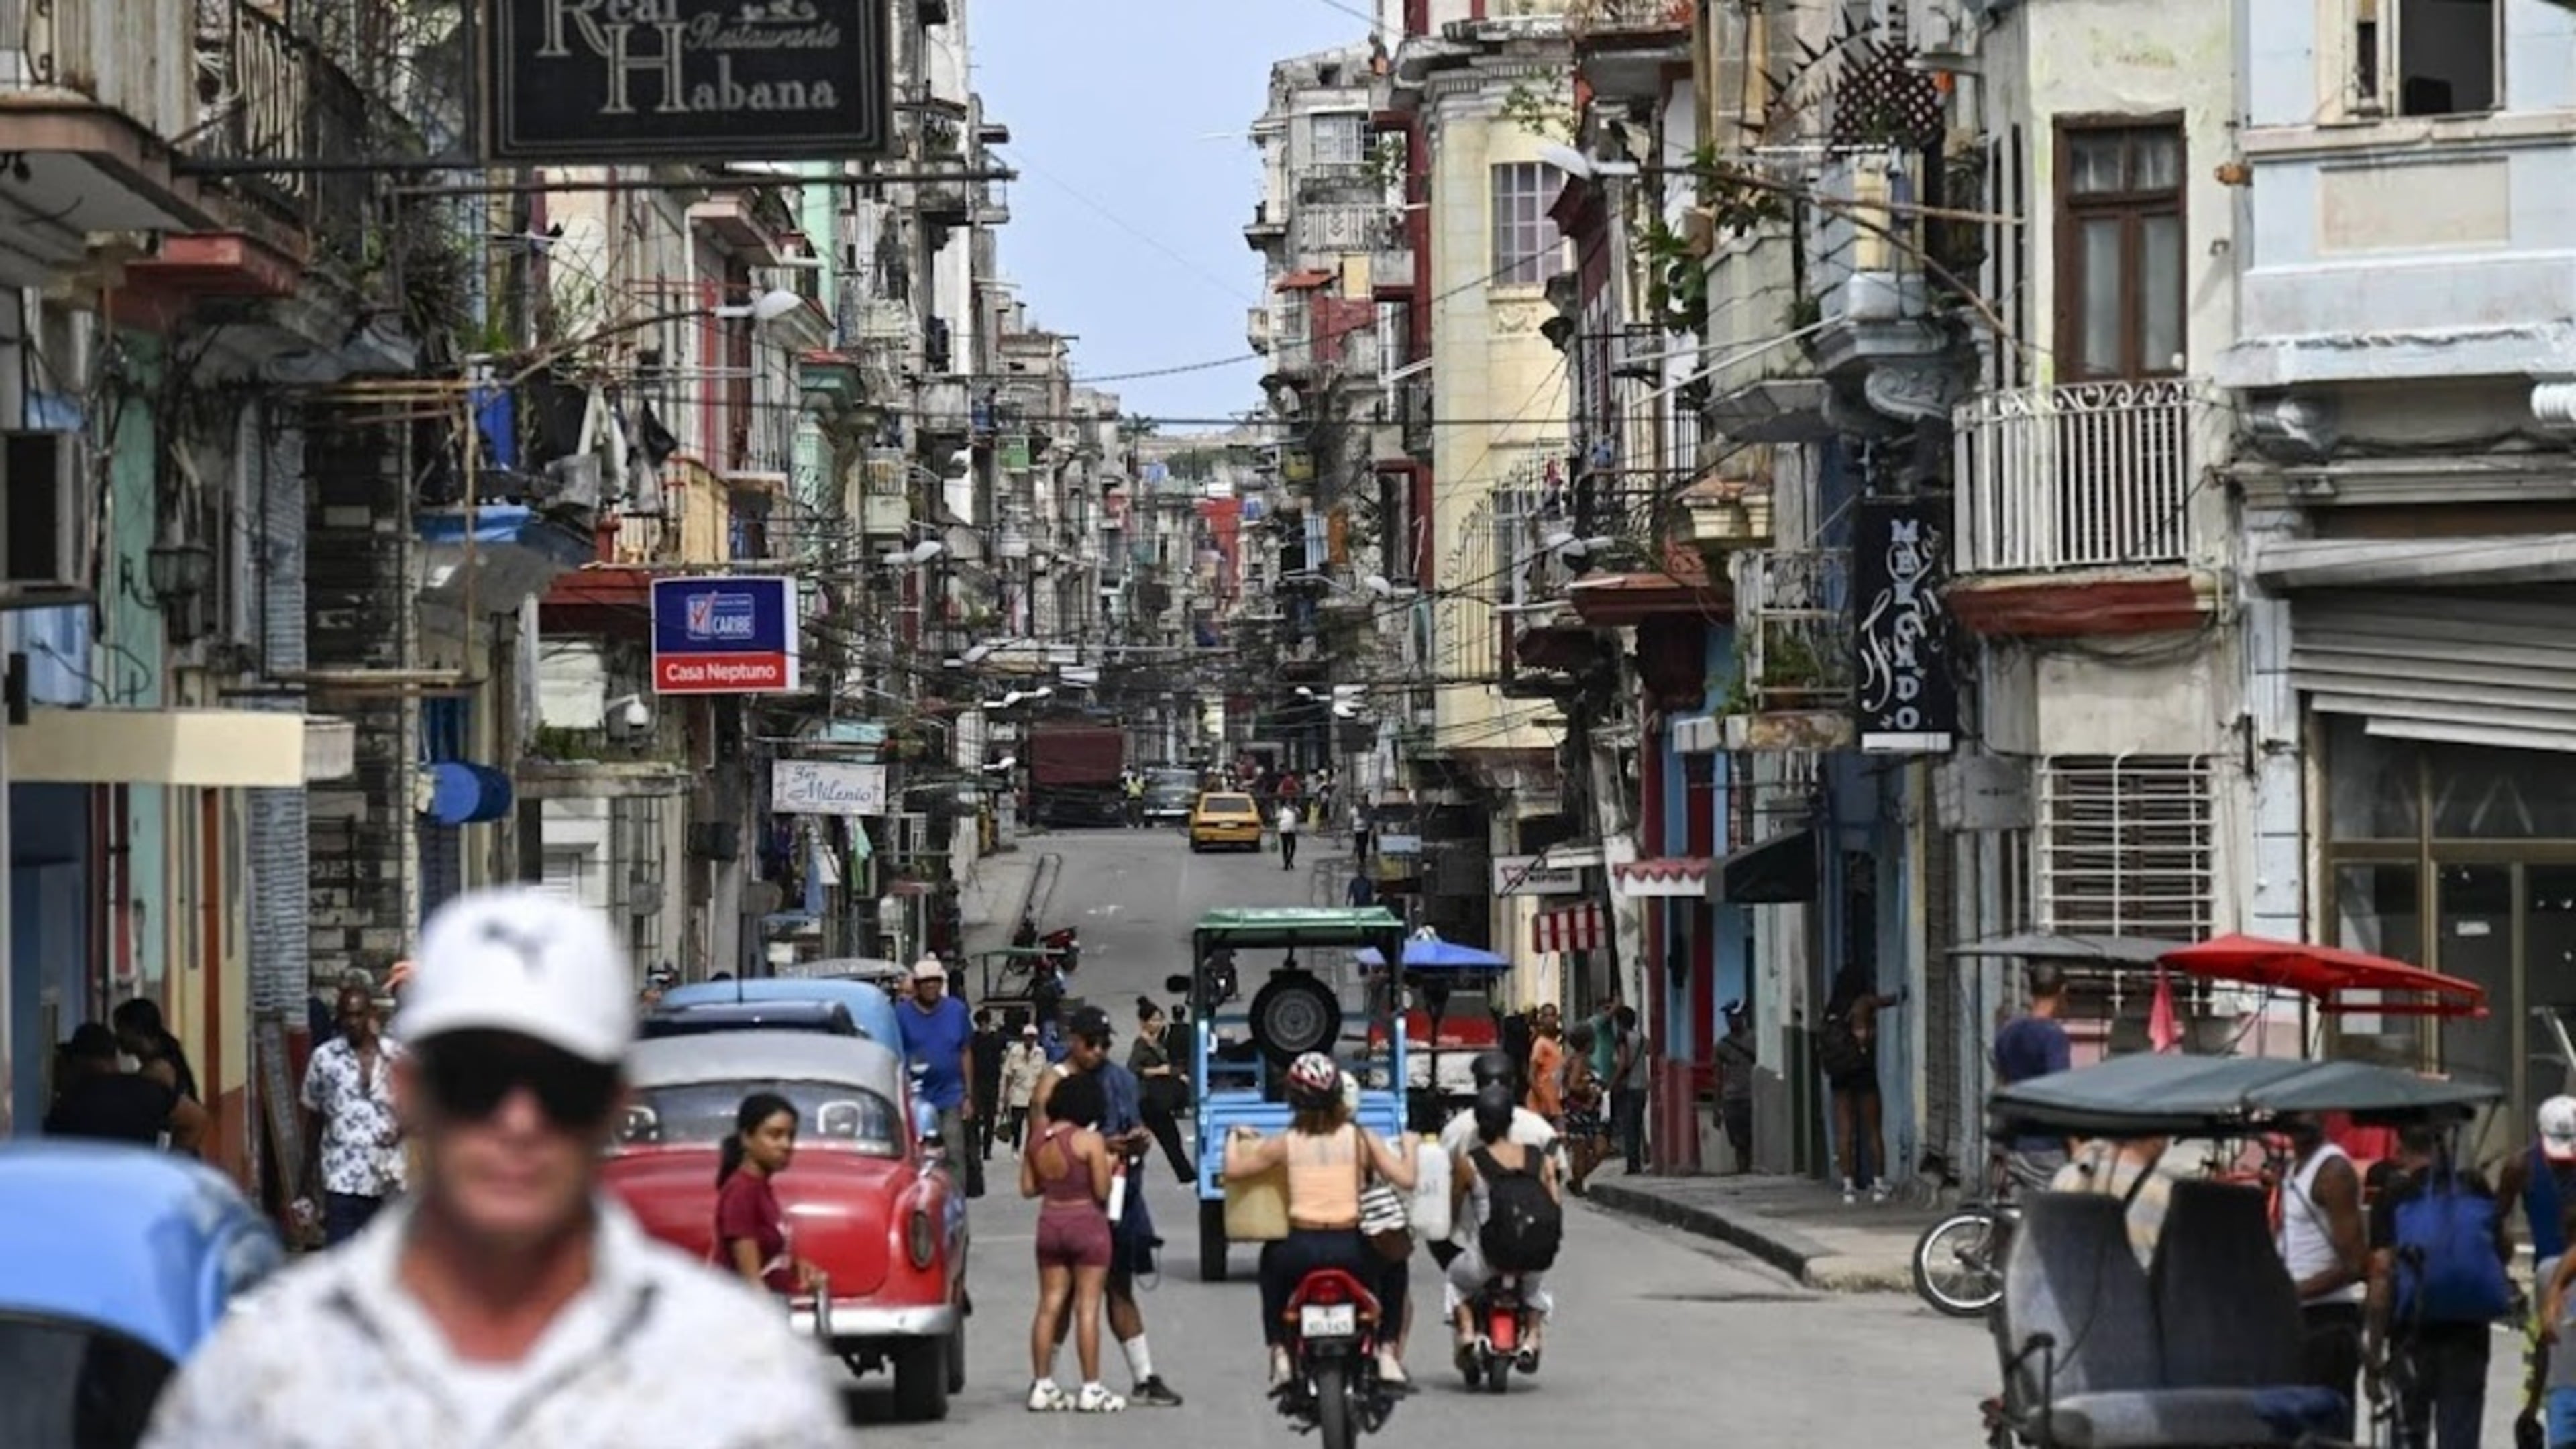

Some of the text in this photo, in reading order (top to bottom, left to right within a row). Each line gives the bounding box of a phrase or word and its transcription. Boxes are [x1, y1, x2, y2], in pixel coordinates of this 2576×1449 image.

[535, 0, 679, 56] Real
[685, 11, 840, 50] Restaurante
[599, 21, 838, 114] Habana
[713, 615, 751, 634] CARIBE
[665, 662, 777, 684] Casa Neptuno
